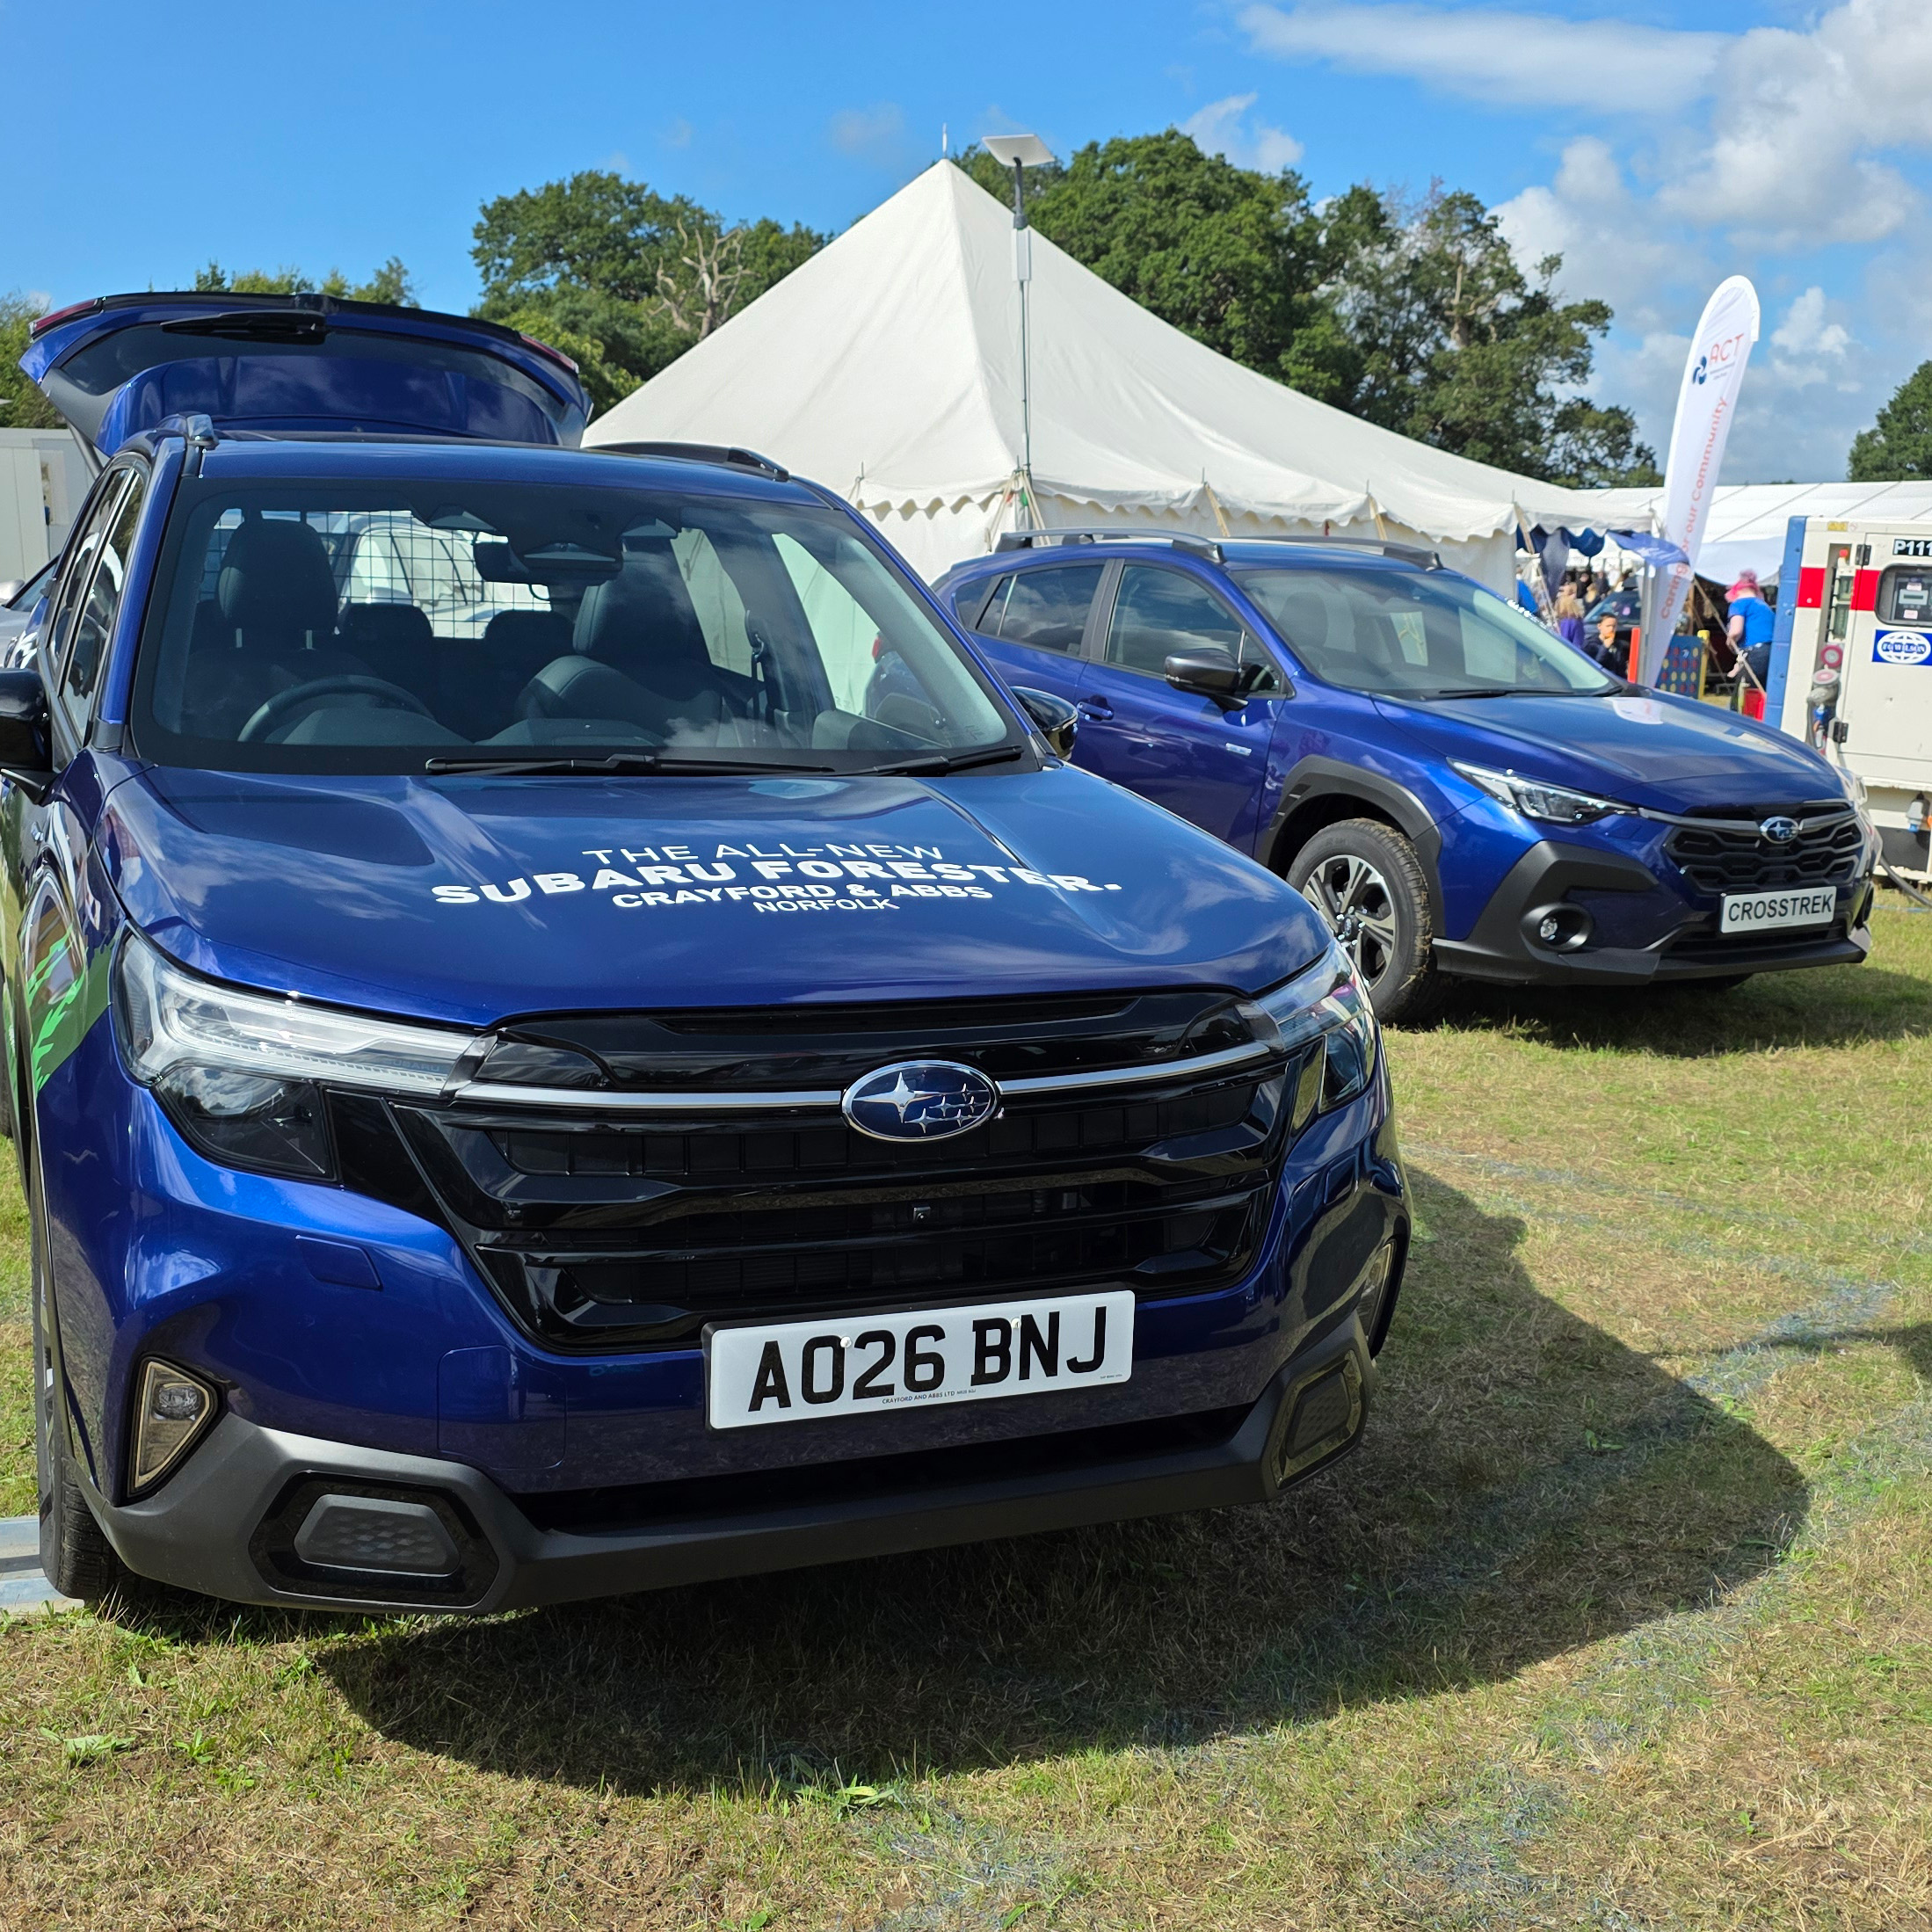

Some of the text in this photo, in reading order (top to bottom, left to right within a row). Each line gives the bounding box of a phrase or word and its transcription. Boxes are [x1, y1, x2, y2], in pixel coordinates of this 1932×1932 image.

[1685, 506, 1697, 533] our
[1691, 396, 1727, 501] Community
[582, 843, 943, 864] THE ALL-NEW
[431, 862, 737, 904] SUBARU
[612, 883, 992, 908] CRAYFORD & ABBS
[752, 897, 900, 913] NORFOLK
[1728, 894, 1833, 921] CROSSTREK
[970, 1306, 1108, 1386] BNJ
[882, 1395, 912, 1405] CRAYFORD
